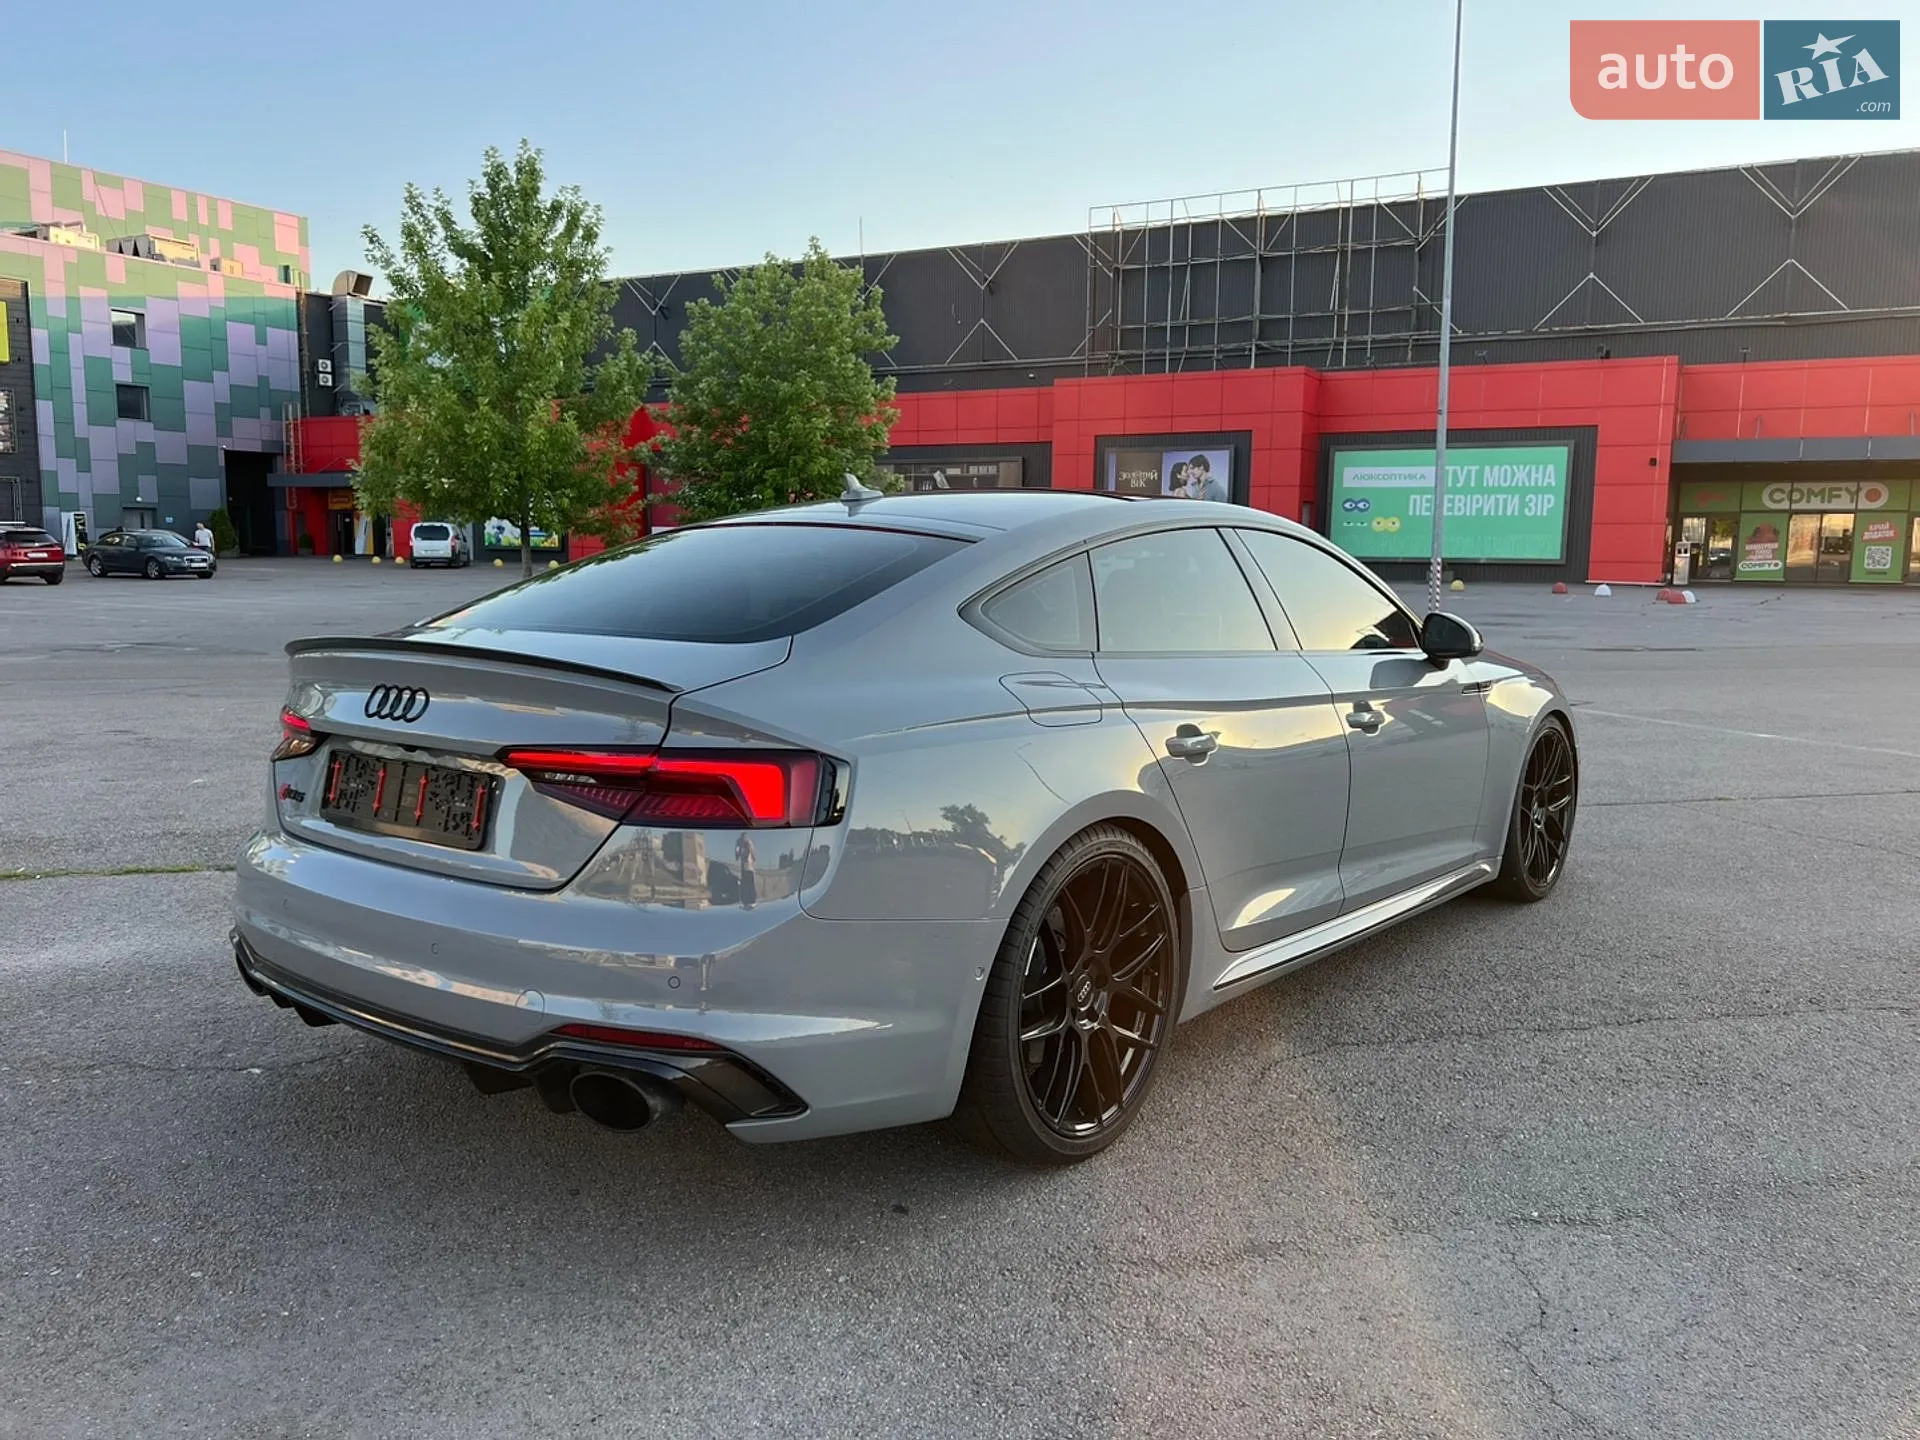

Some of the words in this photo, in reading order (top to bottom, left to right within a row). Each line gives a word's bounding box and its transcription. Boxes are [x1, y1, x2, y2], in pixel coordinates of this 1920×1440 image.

[1445, 465, 1480, 488] ТУТ
[1483, 464, 1556, 488] МОЖНА
[1408, 494, 1520, 517] ПЕЕВІРИТИ
[1524, 494, 1555, 517] ЗІР
